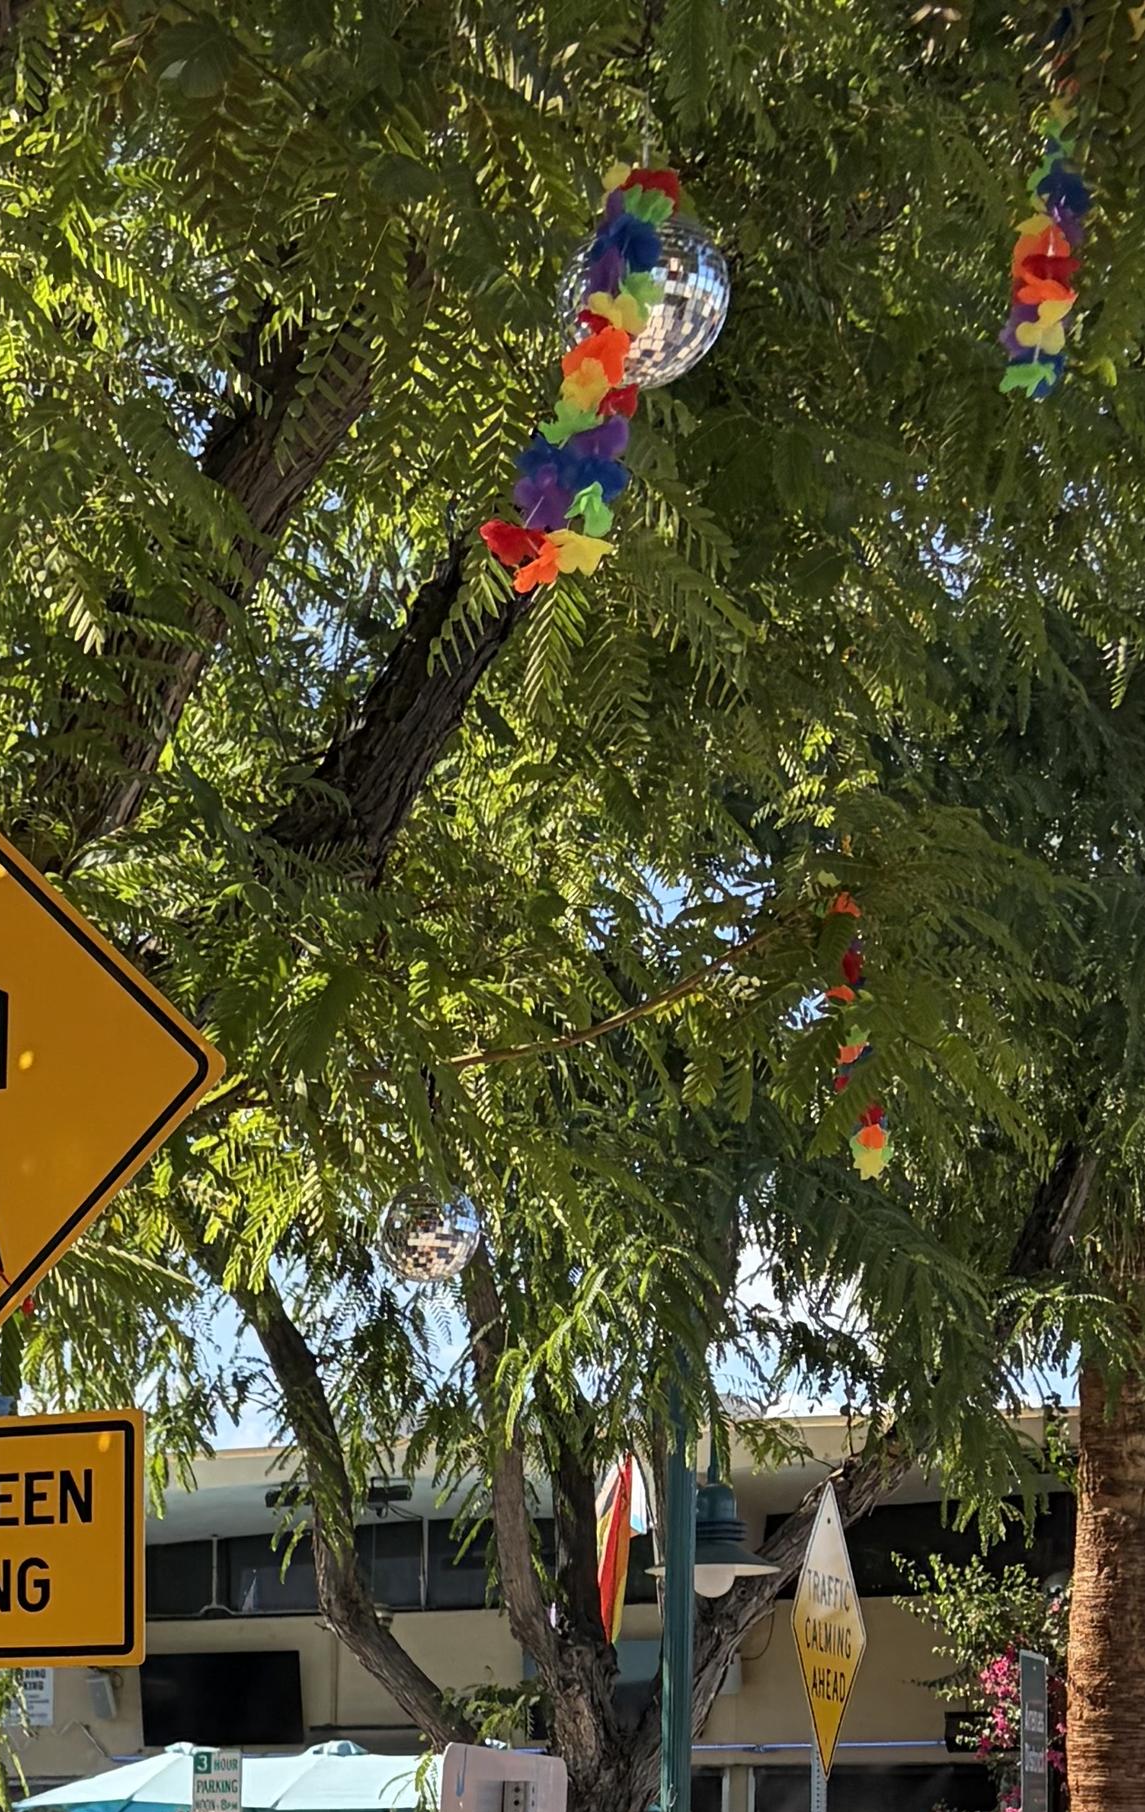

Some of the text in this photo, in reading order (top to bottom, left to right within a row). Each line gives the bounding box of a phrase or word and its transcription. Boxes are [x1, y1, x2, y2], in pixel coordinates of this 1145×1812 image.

[807, 1569, 850, 1611] TRAFFIC
[805, 1618, 852, 1660] CALMING
[811, 1667, 847, 1703] AHEAD
[197, 1754, 238, 1771] 3 HOUR
[196, 1779, 238, 1793] PARKING
